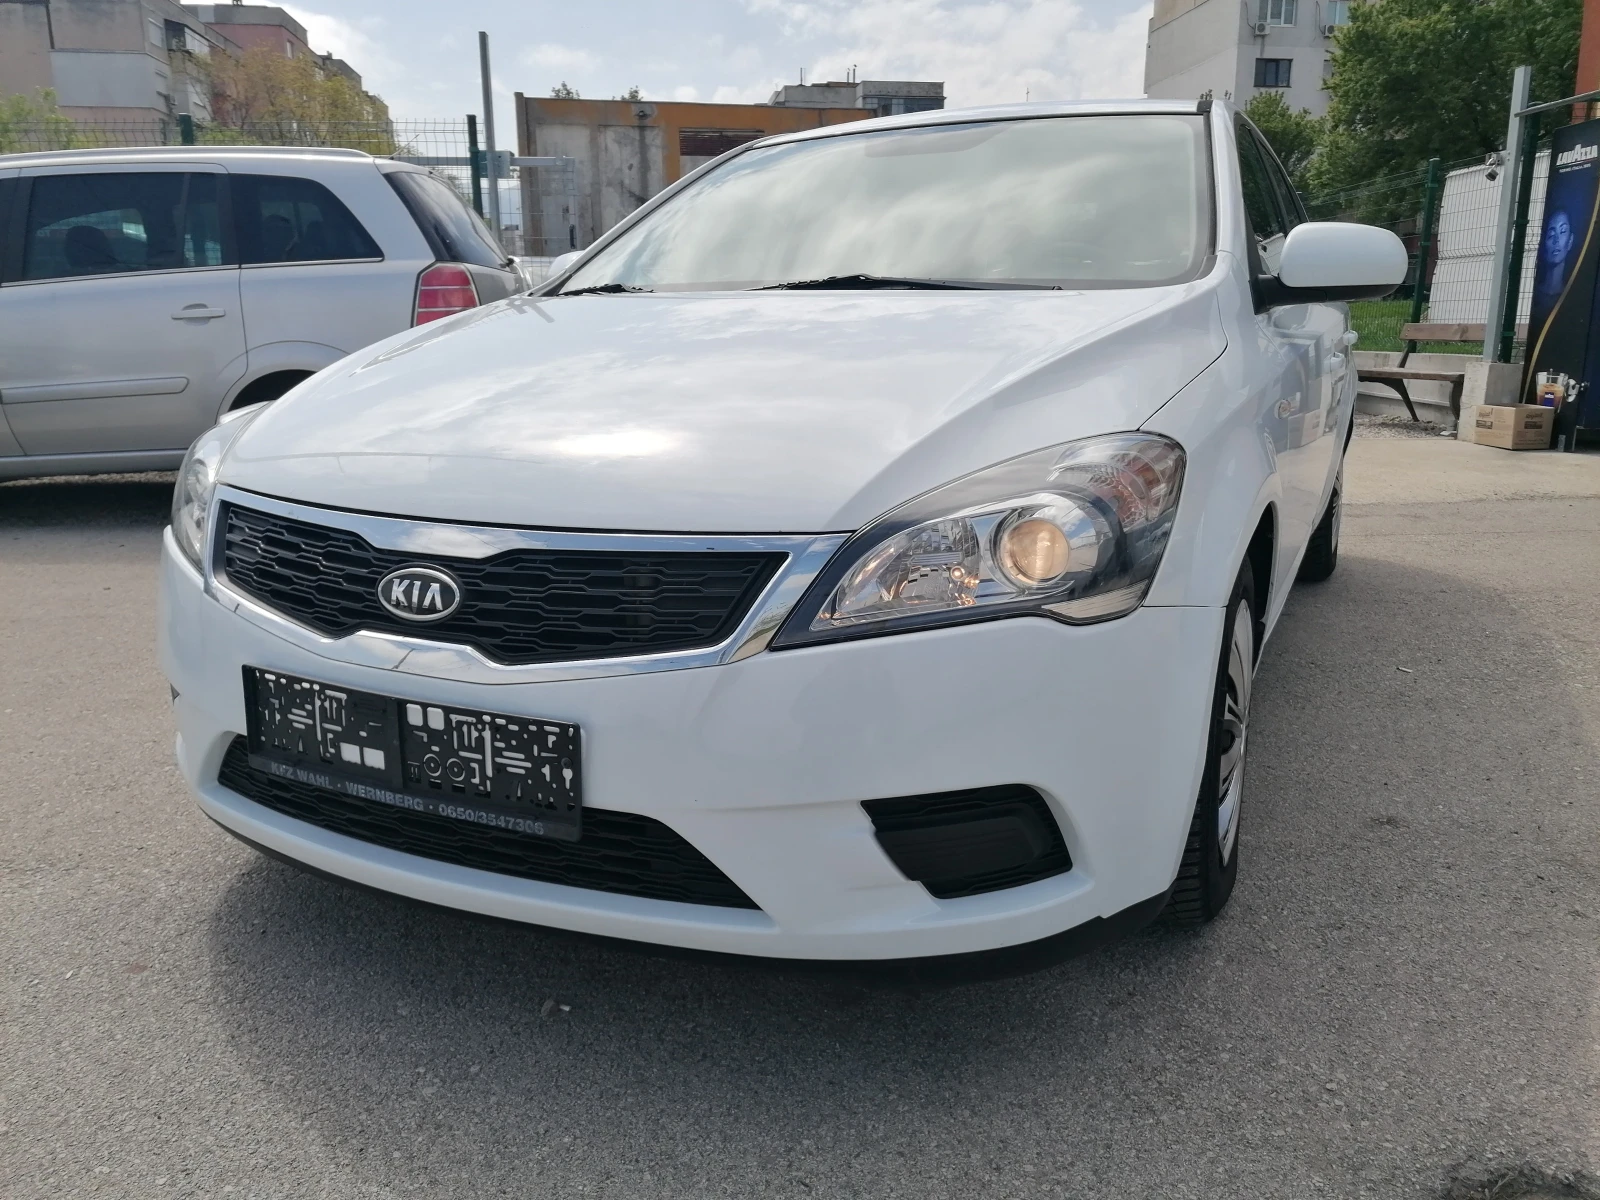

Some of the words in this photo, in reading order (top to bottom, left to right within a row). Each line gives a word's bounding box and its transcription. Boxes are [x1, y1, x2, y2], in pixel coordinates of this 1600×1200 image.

[1556, 143, 1598, 166] LAVAZZA
[391, 578, 443, 611] KIA
[270, 761, 294, 779] KFZ
[297, 769, 334, 790] WAHL
[345, 781, 425, 811] WERNBERG
